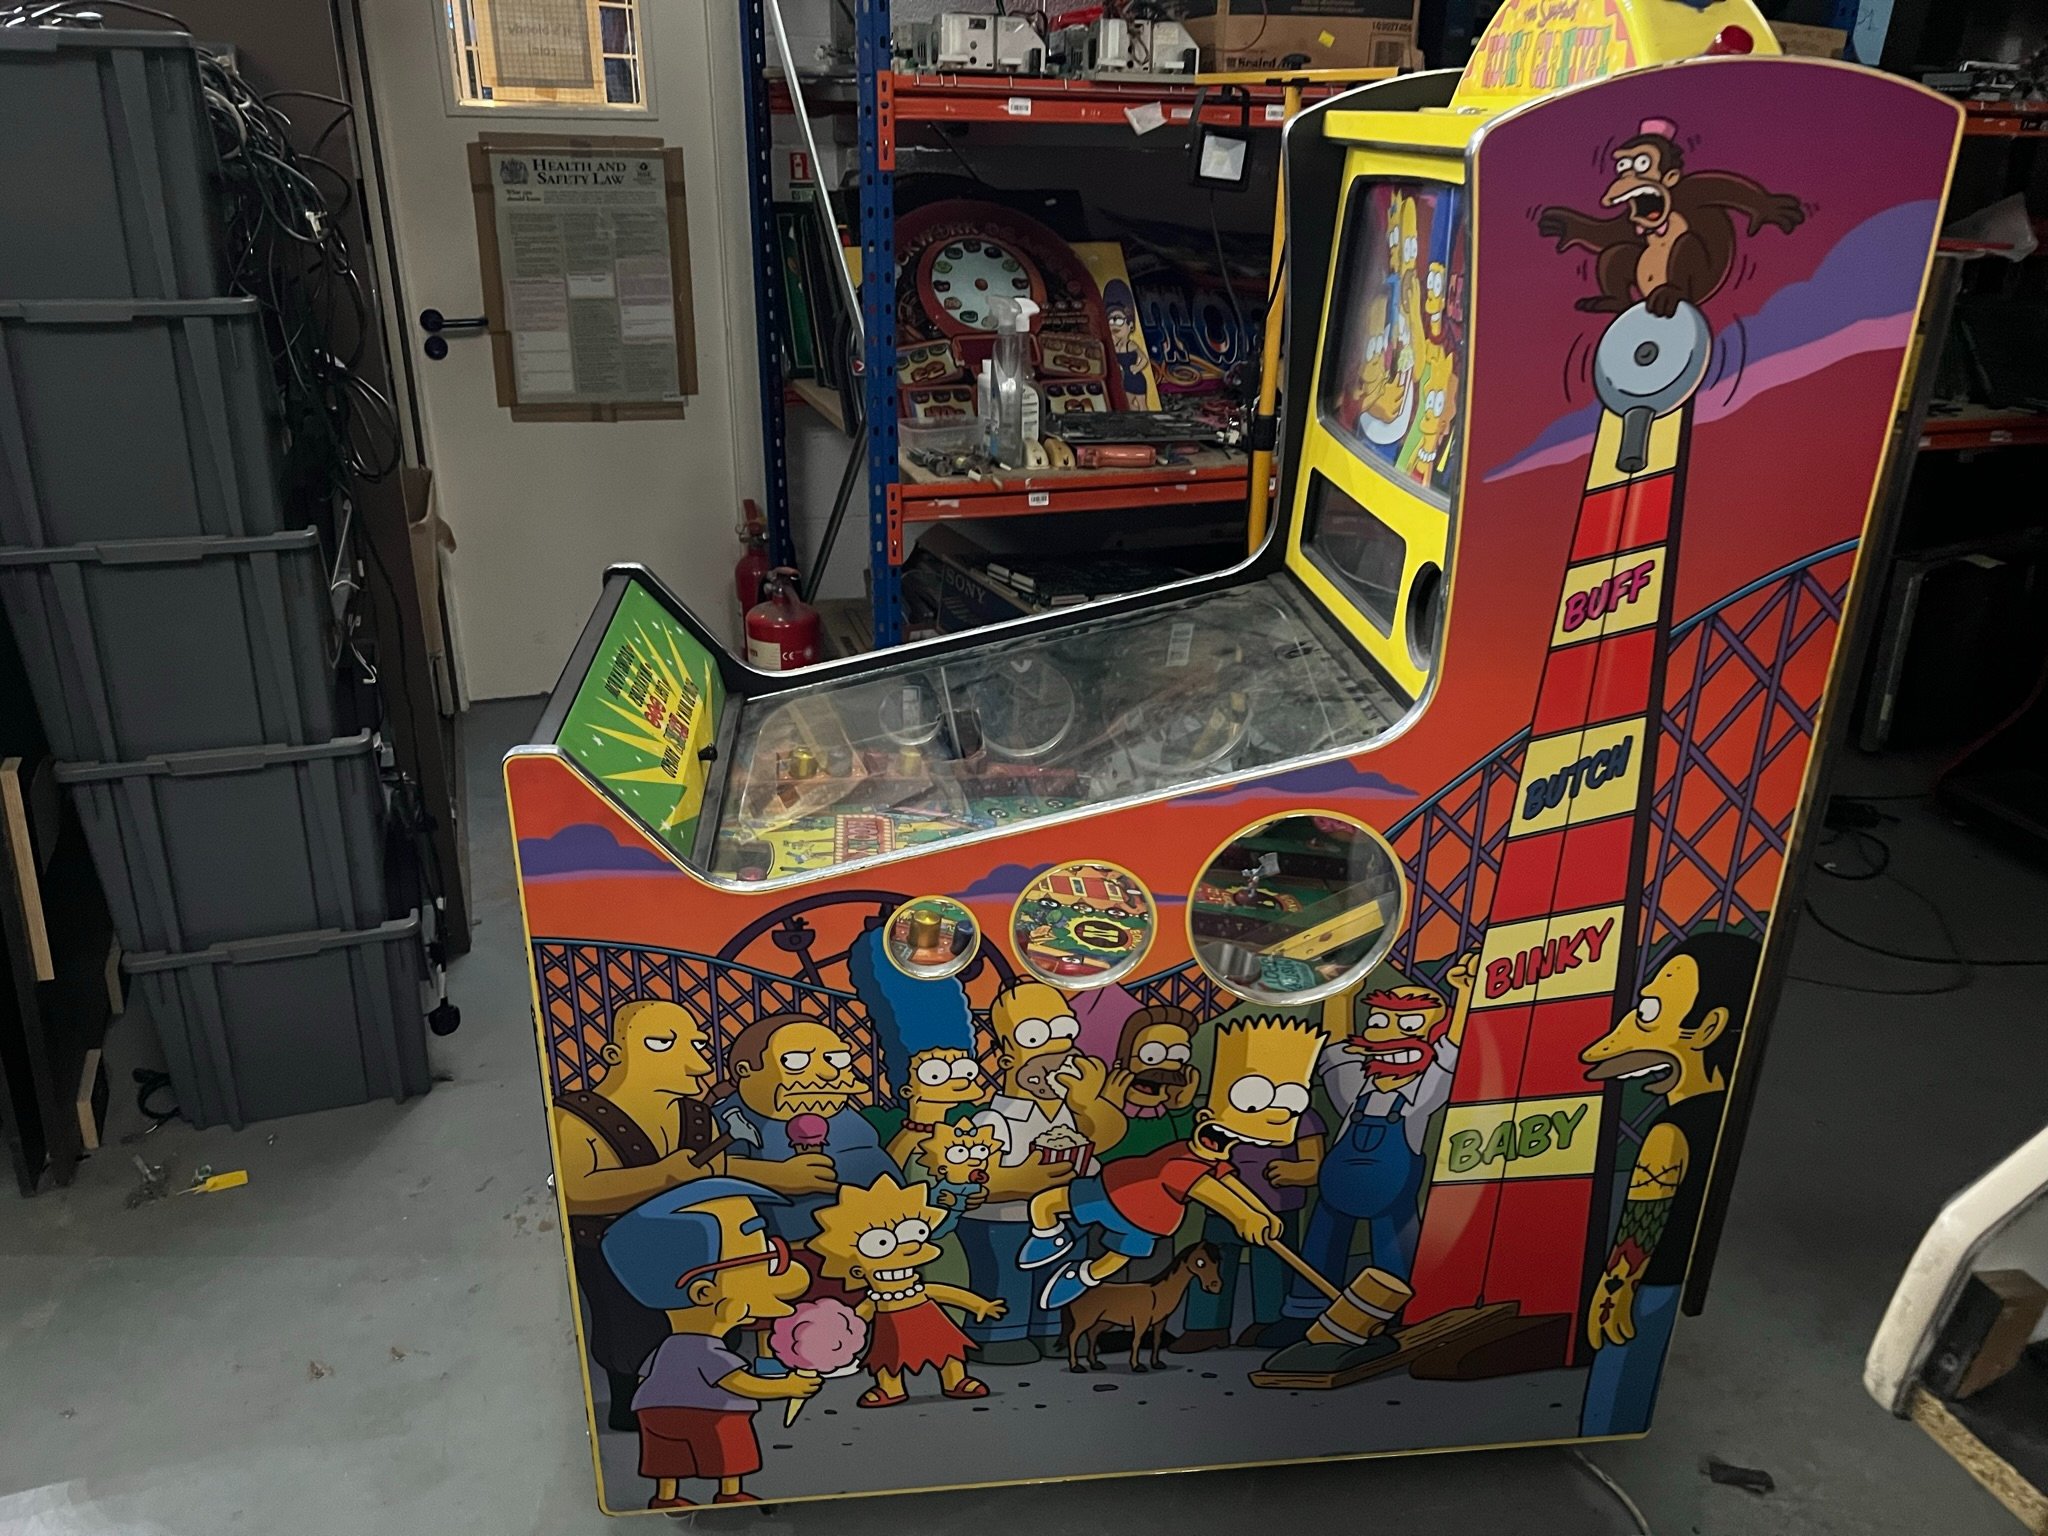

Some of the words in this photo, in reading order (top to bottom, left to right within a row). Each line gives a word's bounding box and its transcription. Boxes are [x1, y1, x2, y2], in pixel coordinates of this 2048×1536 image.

[532, 158, 591, 172] HEALTH
[597, 162, 627, 173] AND
[536, 172, 589, 185] SAFETY
[592, 172, 624, 185] LAW
[945, 567, 987, 605] SONY
[1562, 560, 1655, 633] BUFF
[1521, 735, 1634, 821] BUTCH
[1485, 917, 1615, 999] BINKY
[1448, 1103, 1588, 1173] BABY
